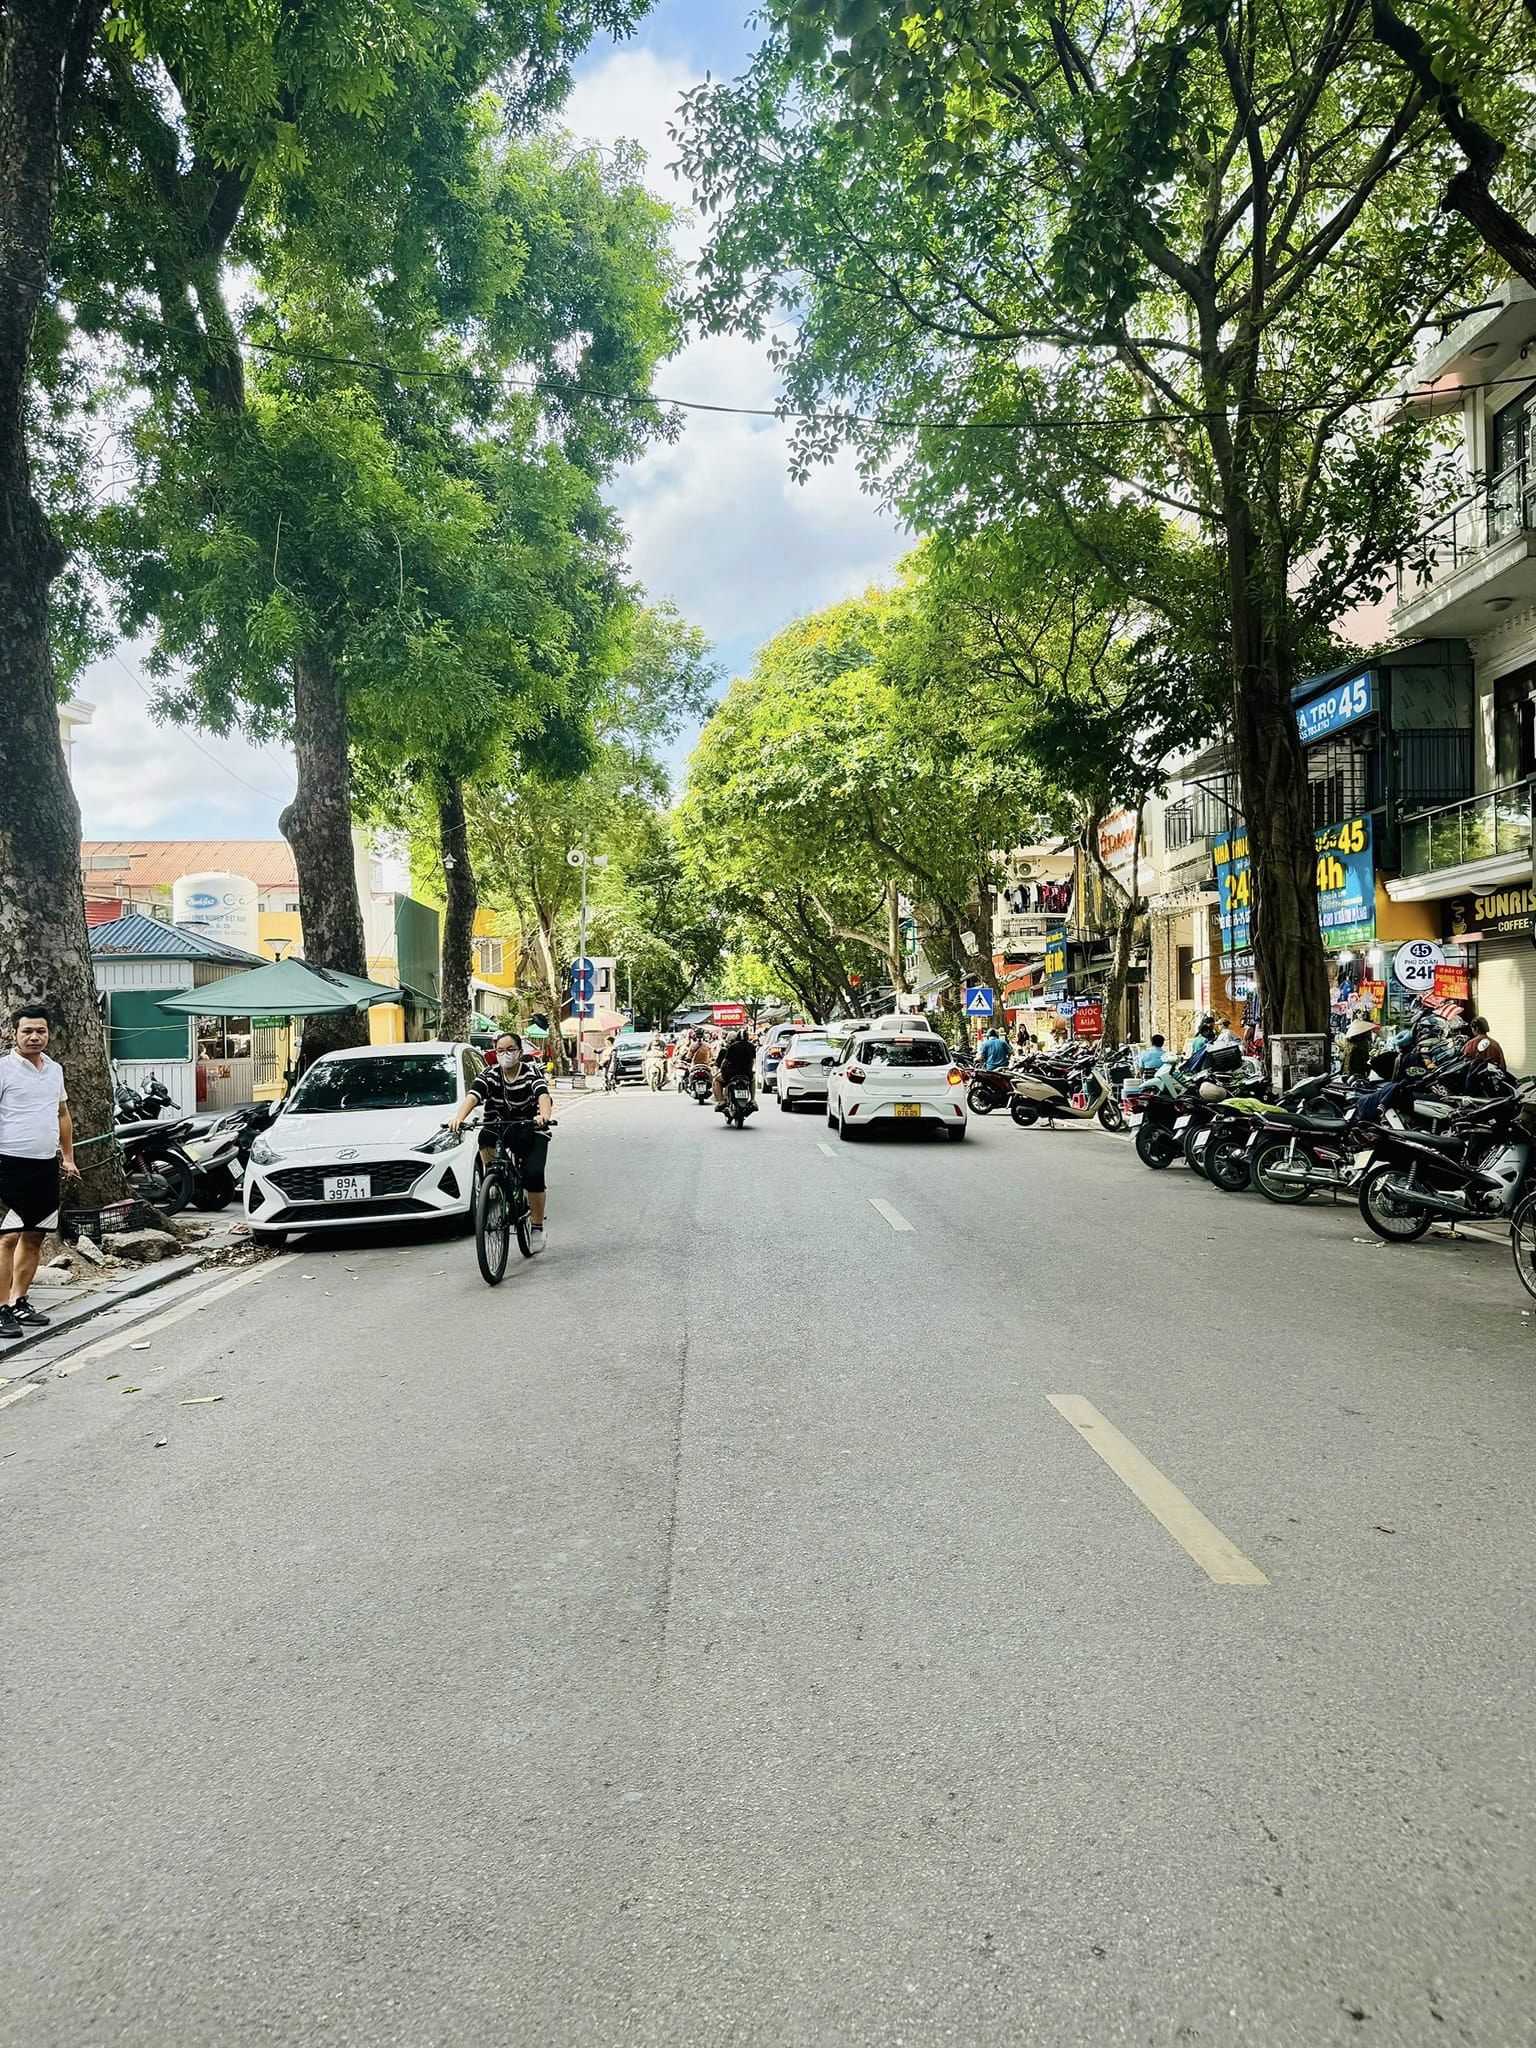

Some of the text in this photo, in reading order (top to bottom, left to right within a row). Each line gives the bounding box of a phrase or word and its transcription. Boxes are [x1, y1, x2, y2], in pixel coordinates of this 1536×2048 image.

[1296, 678, 1367, 728] À TRỌ 45
[1338, 819, 1365, 855] 45
[1225, 869, 1251, 911] 24
[1498, 918, 1529, 932] COFFEE
[1412, 945, 1429, 957] 45
[337, 1178, 357, 1188] 89A
[329, 1187, 365, 1200] 397.11
